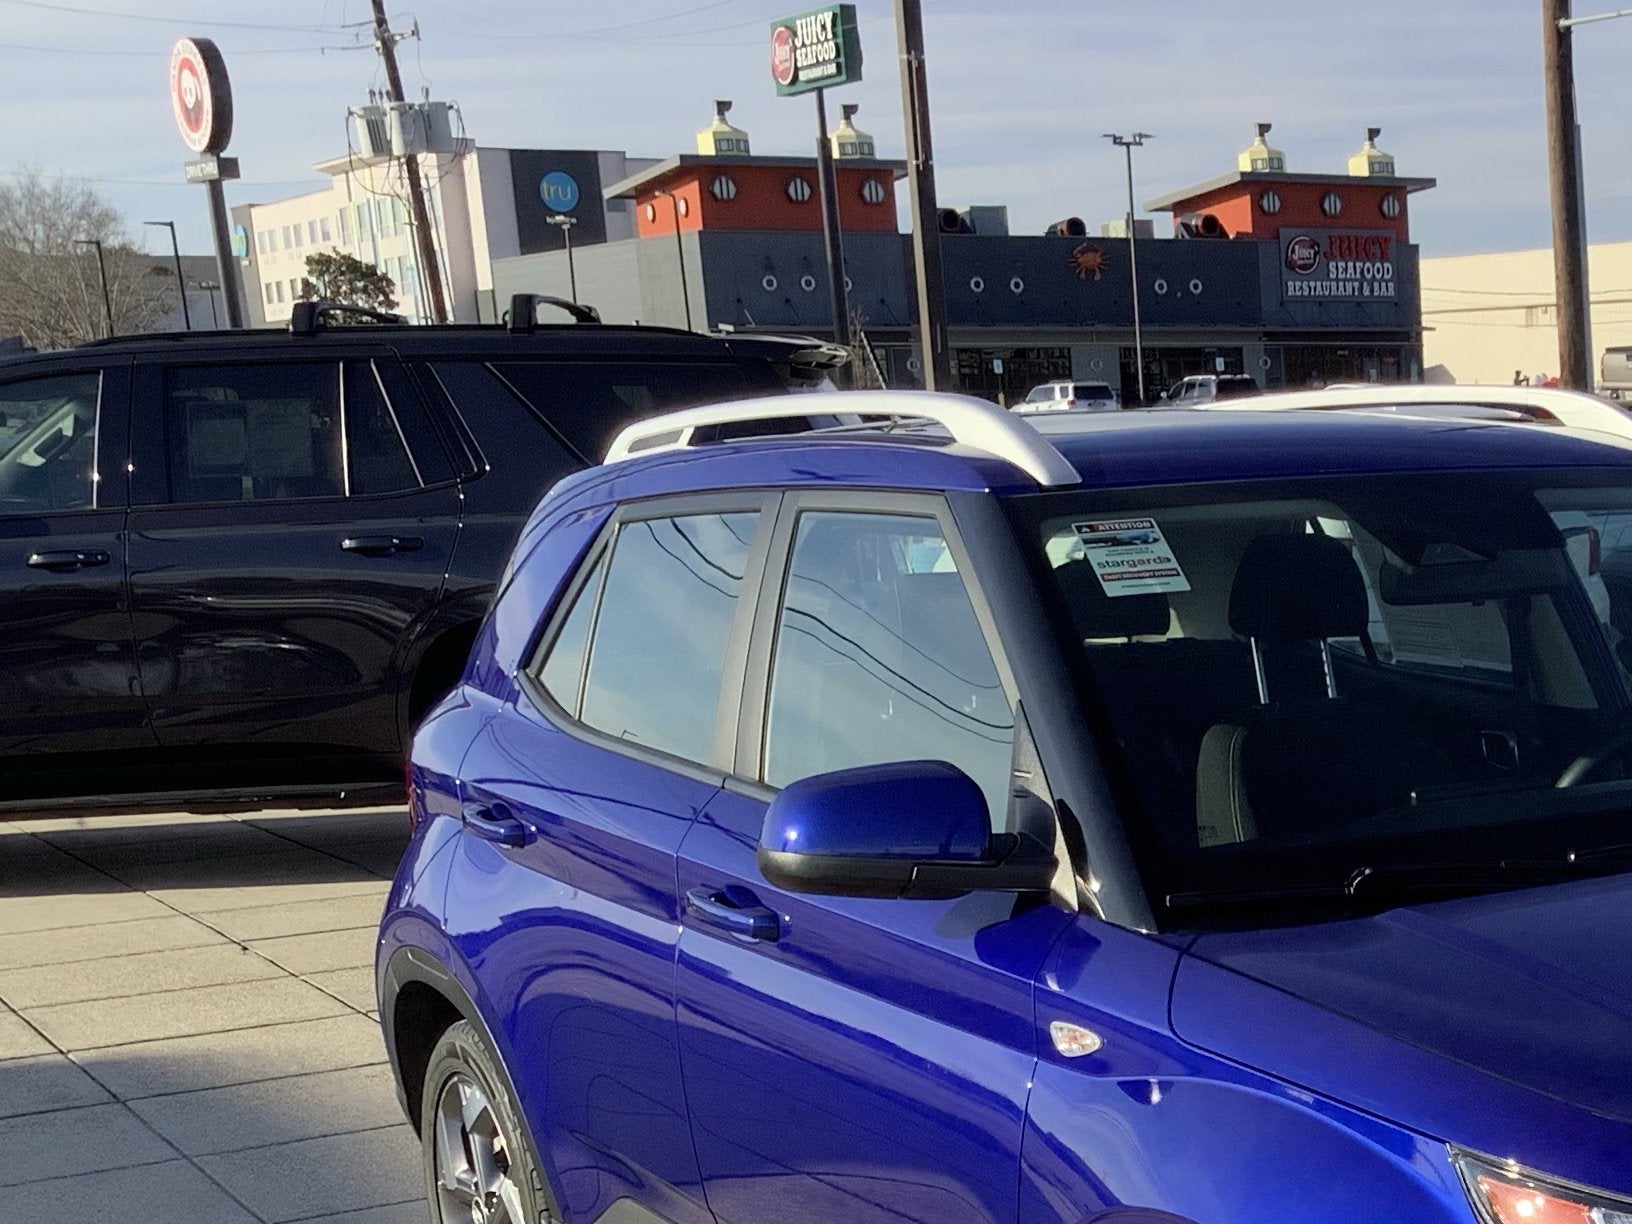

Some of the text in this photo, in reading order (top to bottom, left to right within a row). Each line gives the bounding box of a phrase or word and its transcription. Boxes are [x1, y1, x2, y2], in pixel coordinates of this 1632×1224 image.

[795, 11, 833, 47] JUICY
[796, 41, 836, 67] SEAFOOD
[542, 181, 571, 200] tru
[1323, 236, 1391, 261] JUICY
[1329, 262, 1393, 279] SEAFOOD
[1287, 281, 1395, 296] RESTAURANT & BAR
[1098, 521, 1152, 532] ATTENTION
